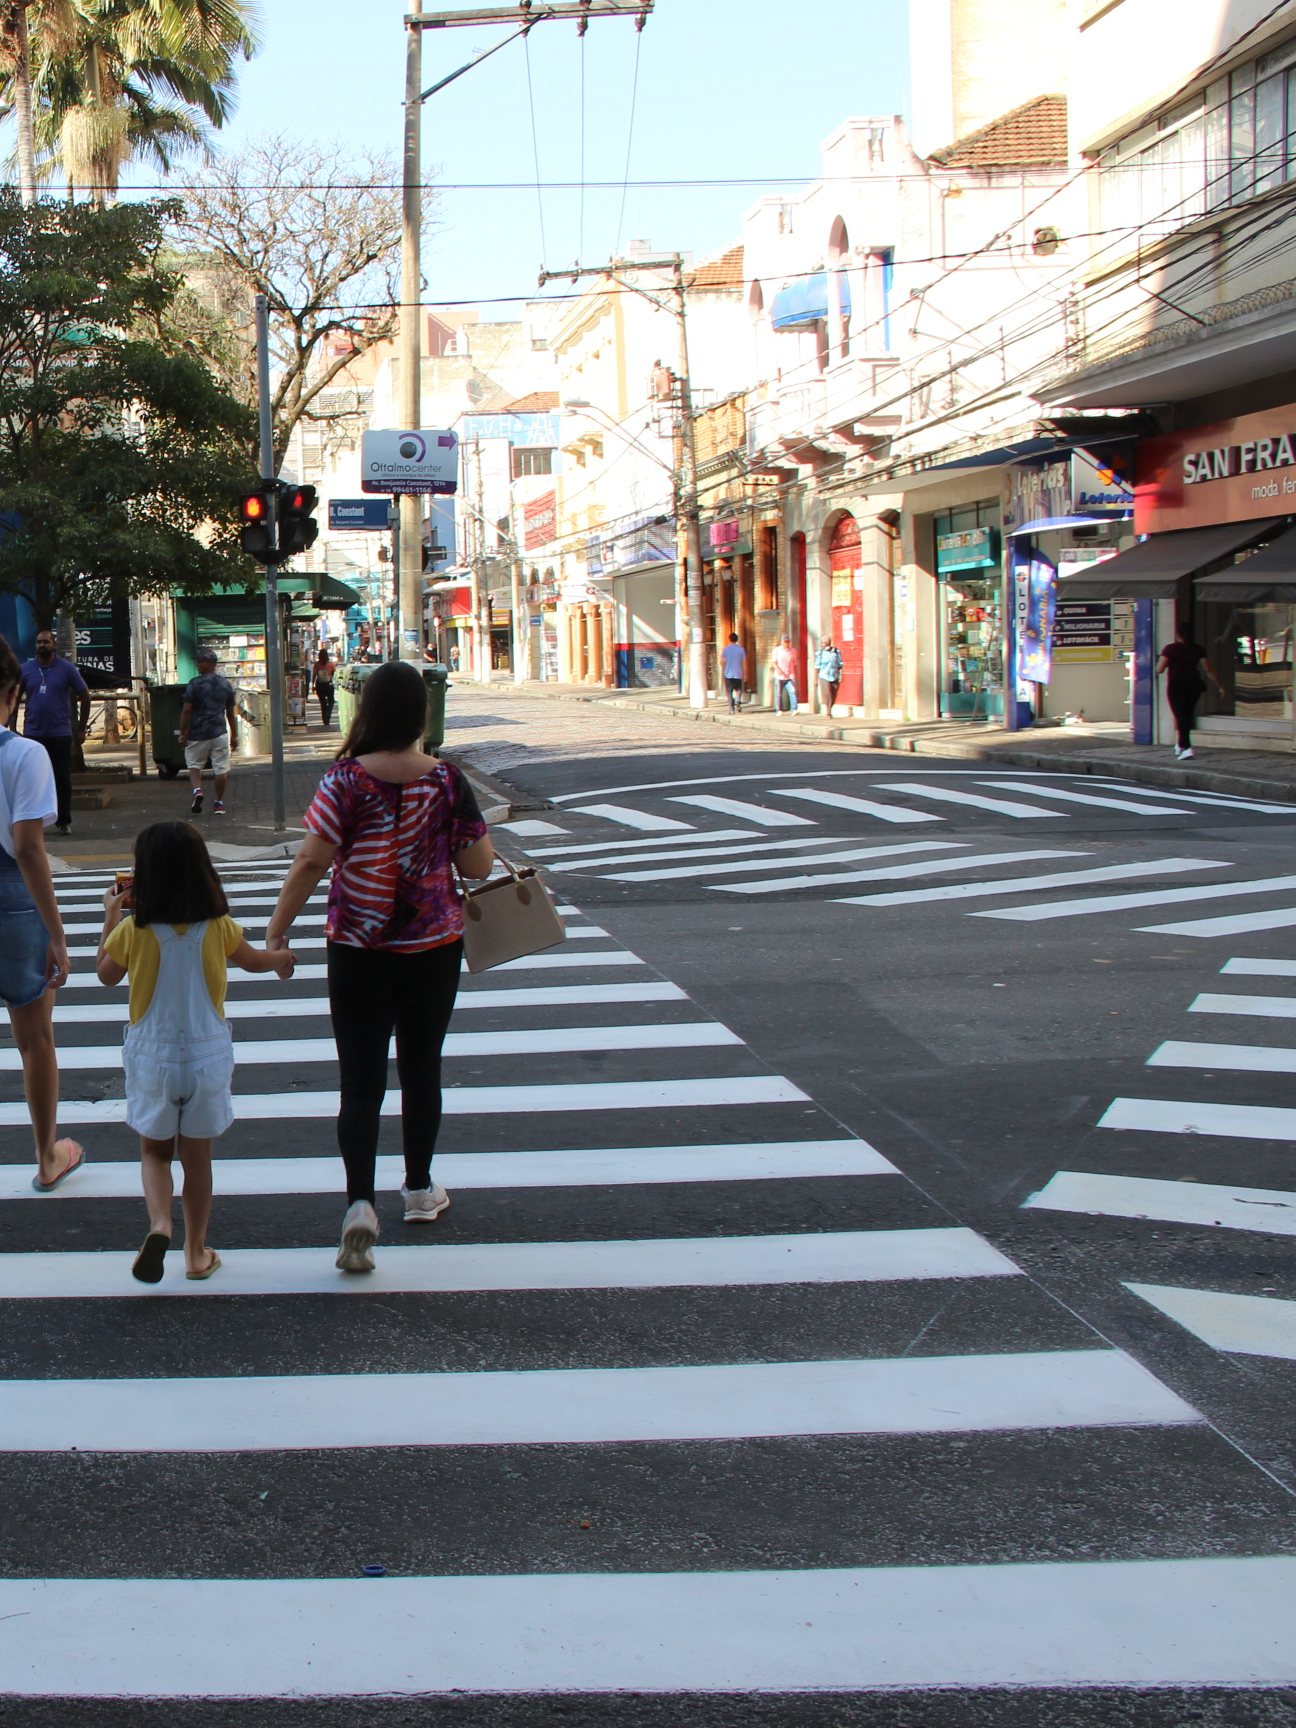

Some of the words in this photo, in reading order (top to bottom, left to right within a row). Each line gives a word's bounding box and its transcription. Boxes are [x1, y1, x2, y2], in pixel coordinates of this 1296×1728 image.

[1183, 446, 1231, 485] SAN
[1238, 433, 1296, 475] FRA
[370, 461, 443, 473] Oftalmocenter
[1017, 461, 1065, 496] Loterias
[1251, 479, 1279, 499] moda
[329, 506, 336, 517] B.
[337, 506, 365, 517] Constant
[1063, 606, 1087, 614] QUINA
[104, 655, 114, 666] DE
